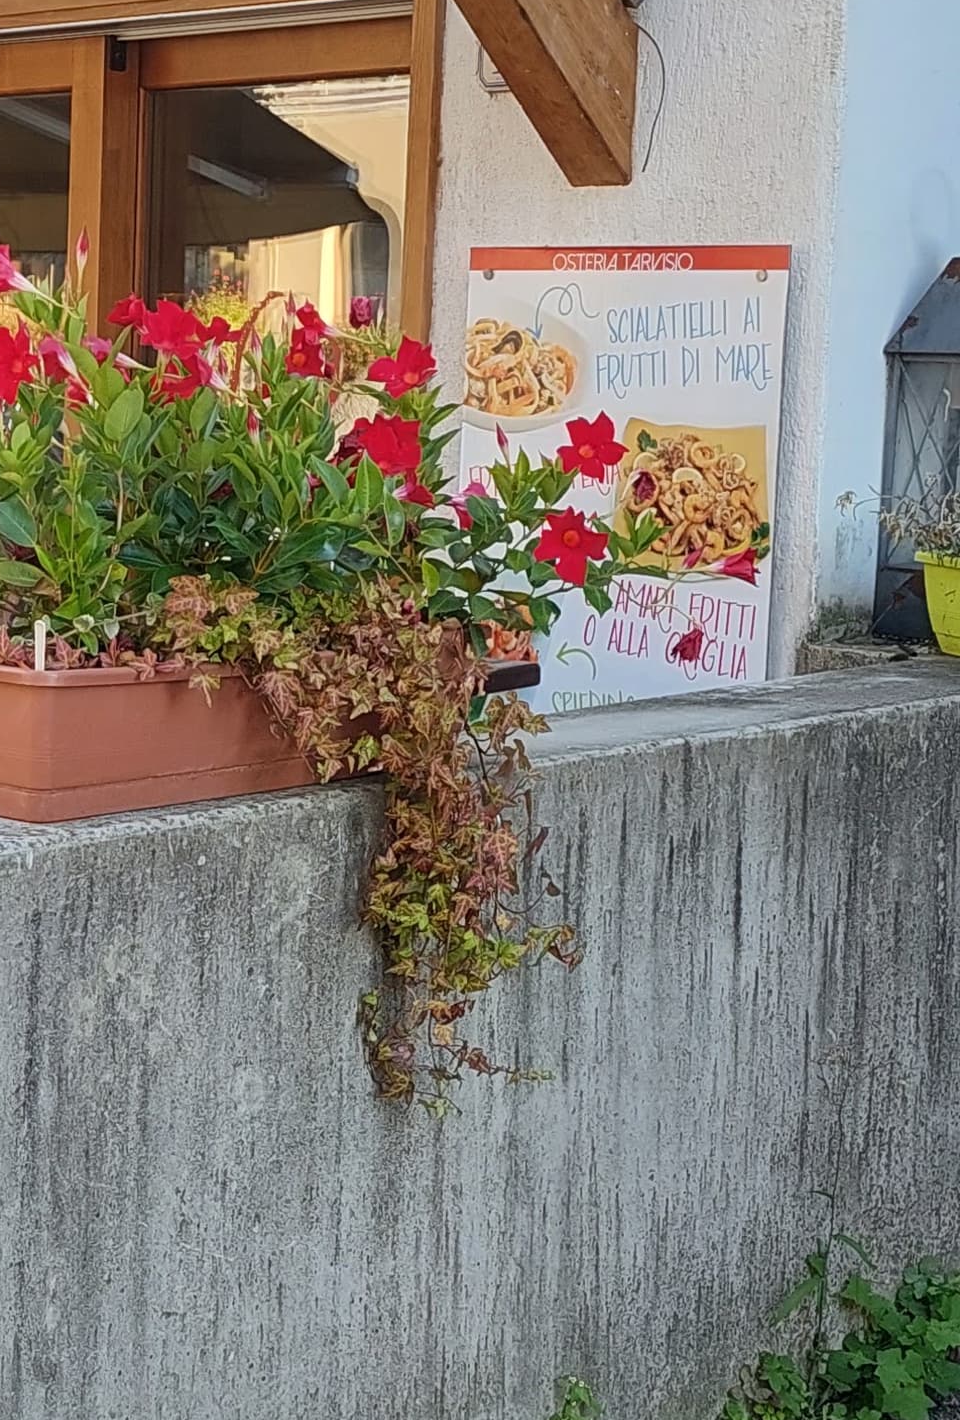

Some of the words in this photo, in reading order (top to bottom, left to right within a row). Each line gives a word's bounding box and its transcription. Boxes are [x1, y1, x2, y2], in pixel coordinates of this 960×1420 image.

[552, 252, 618, 272] OSTERIA
[621, 251, 694, 272] TARVISIO
[606, 301, 728, 345] SCIALATIELLI
[743, 296, 761, 334] AI
[596, 350, 669, 400] FRUTTI
[682, 348, 700, 388] DI
[717, 342, 775, 392] MARE
[688, 592, 757, 642] FRITTI
[583, 613, 596, 646] O
[607, 617, 649, 659] ALLA
[664, 630, 747, 681] GGLIA
